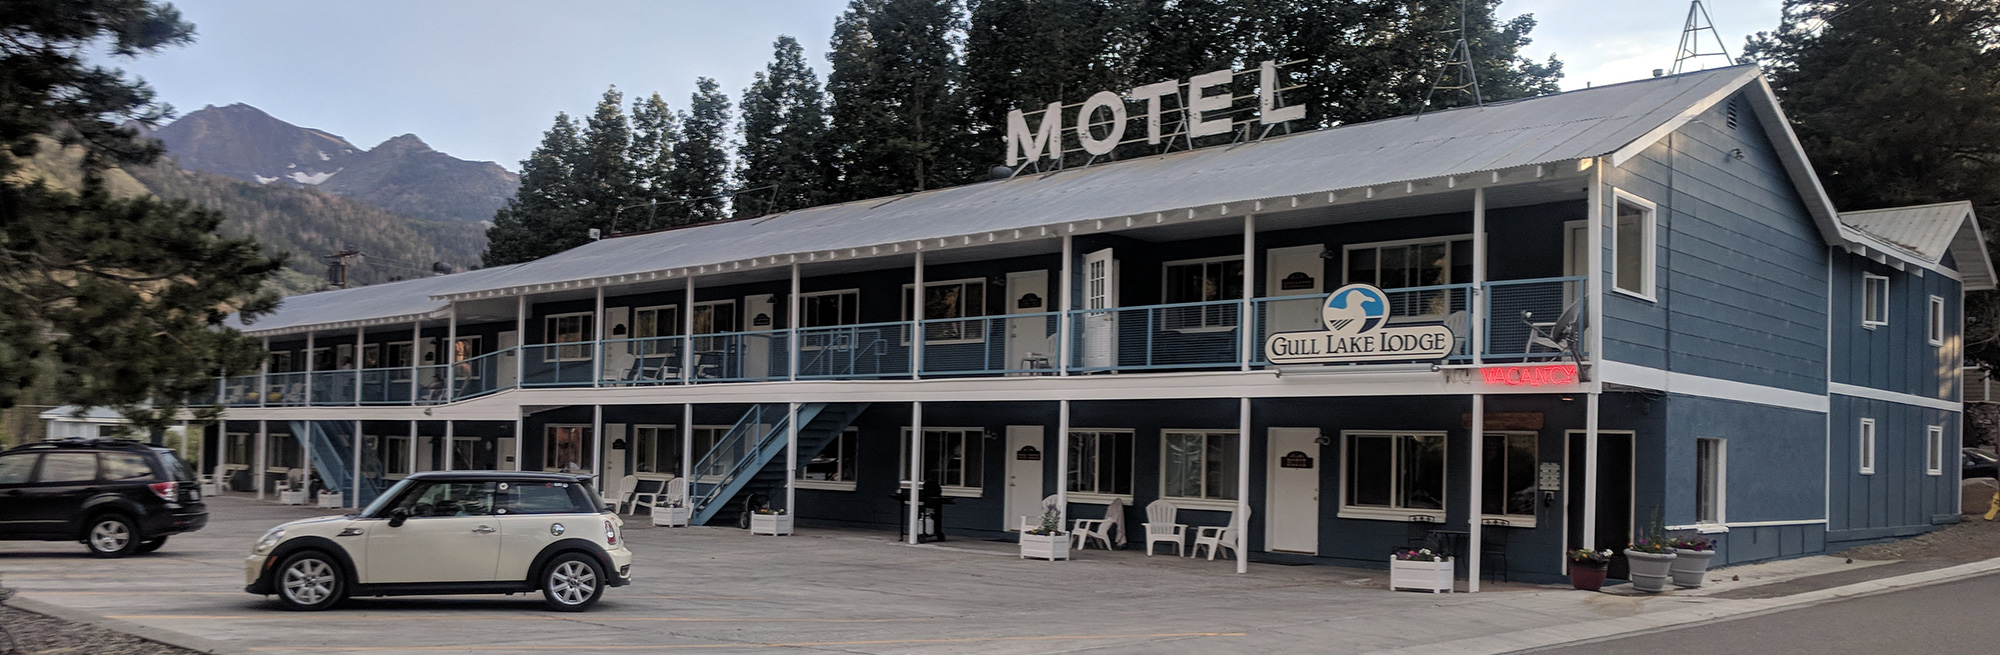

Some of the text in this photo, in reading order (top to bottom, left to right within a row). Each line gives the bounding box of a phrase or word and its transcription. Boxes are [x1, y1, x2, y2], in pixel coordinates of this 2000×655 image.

[1006, 60, 1306, 166] MOTEL
[1272, 332, 1446, 356] GULL LAKE LODGE
[1481, 365, 1577, 386] VACANCY
